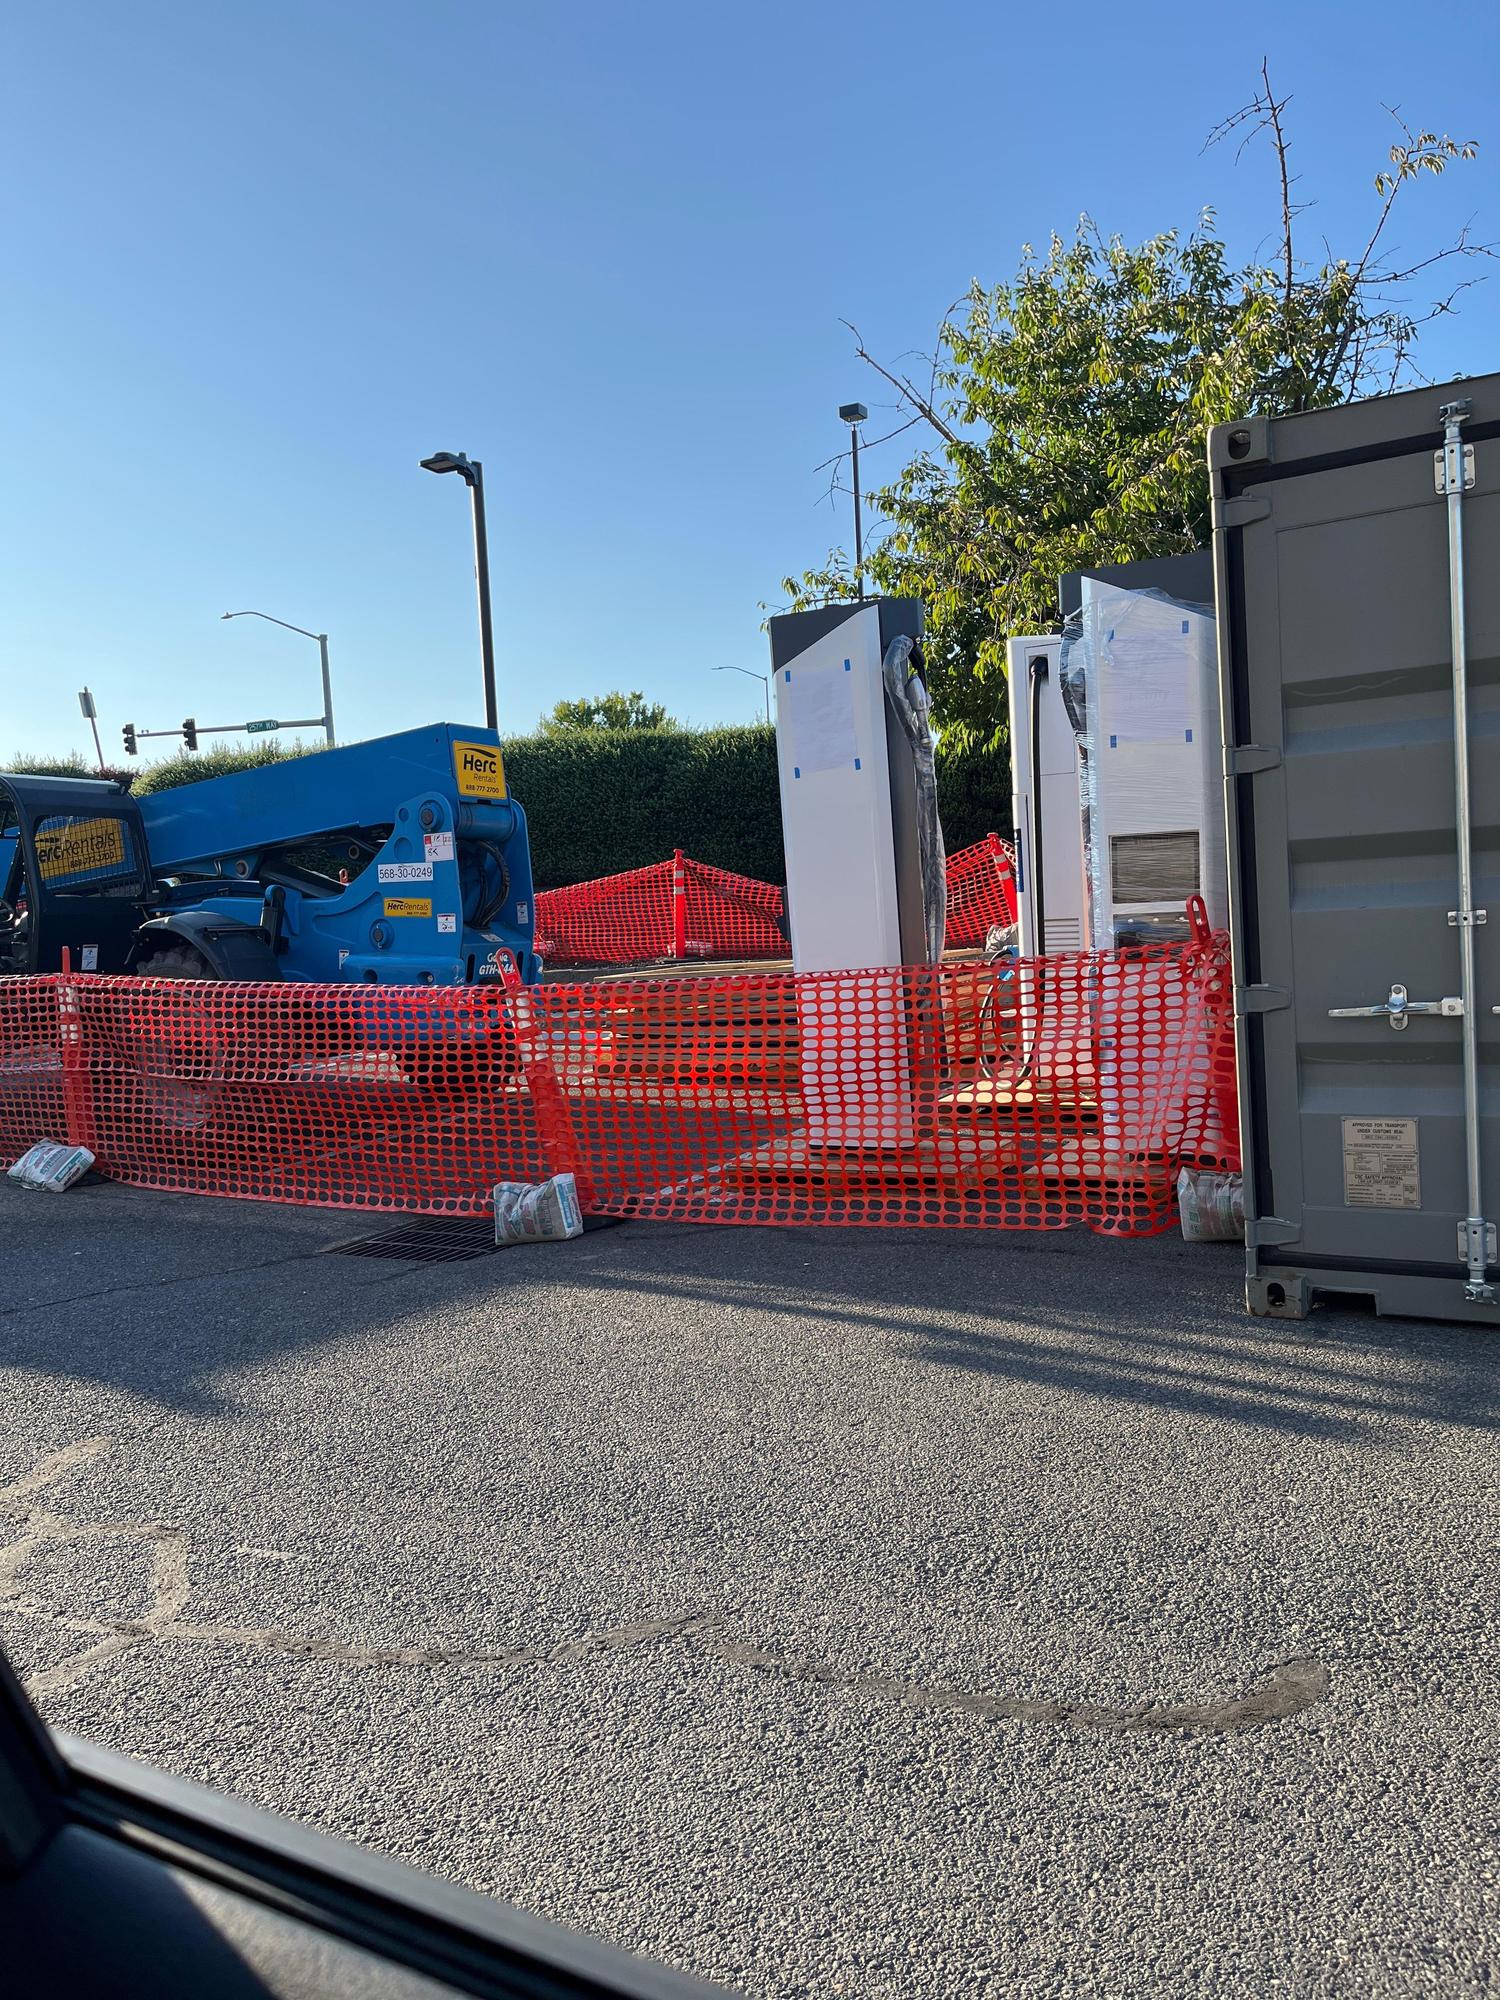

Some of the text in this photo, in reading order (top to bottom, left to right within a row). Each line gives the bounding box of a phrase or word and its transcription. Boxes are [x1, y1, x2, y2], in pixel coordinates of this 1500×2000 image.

[265, 721, 277, 729] WAY
[463, 753, 497, 774] Herc
[473, 773, 497, 784] Rentals
[38, 833, 116, 863] ercRentals
[379, 867, 432, 879] 568-30-0249
